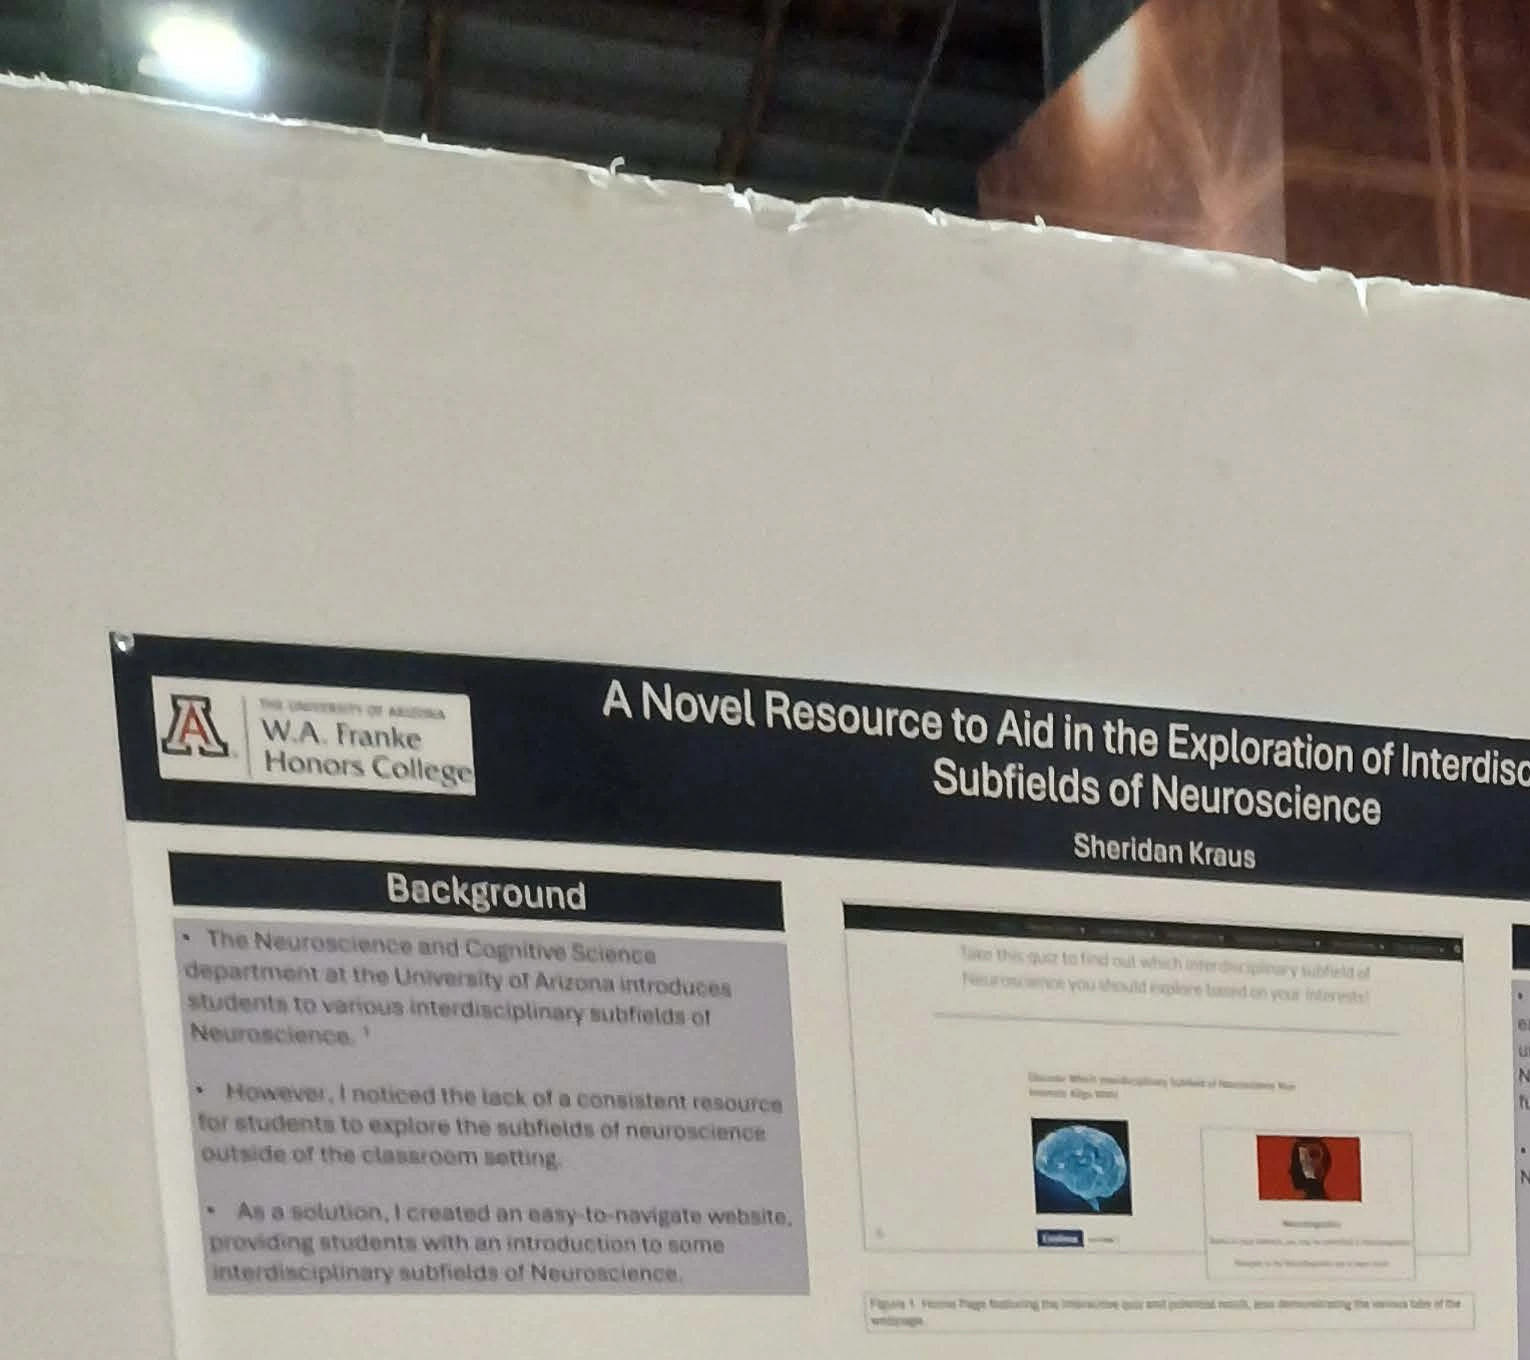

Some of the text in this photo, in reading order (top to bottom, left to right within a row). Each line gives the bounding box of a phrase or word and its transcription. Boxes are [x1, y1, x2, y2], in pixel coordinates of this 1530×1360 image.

[335, 721, 422, 750] Franke
[602, 678, 633, 718] A
[641, 681, 755, 726] Novel
[764, 689, 942, 739] Resource
[950, 707, 988, 743] to
[996, 708, 1055, 752] Aid
[1063, 712, 1094, 754] in
[1101, 717, 1160, 759] the
[1168, 721, 1354, 777] Exploration
[1362, 741, 1396, 776] of
[264, 749, 474, 789] Honors College
[933, 757, 1381, 824] Subfields of Neuroscience
[1073, 832, 1256, 868] Sheridan Kraus
[386, 872, 586, 912] Background
[205, 927, 656, 965] The Neuroscience and Cognitive Science
[182, 960, 732, 998] department at the University of Arizona introduces
[186, 992, 711, 1027] students to various interdisciplinary subfields of
